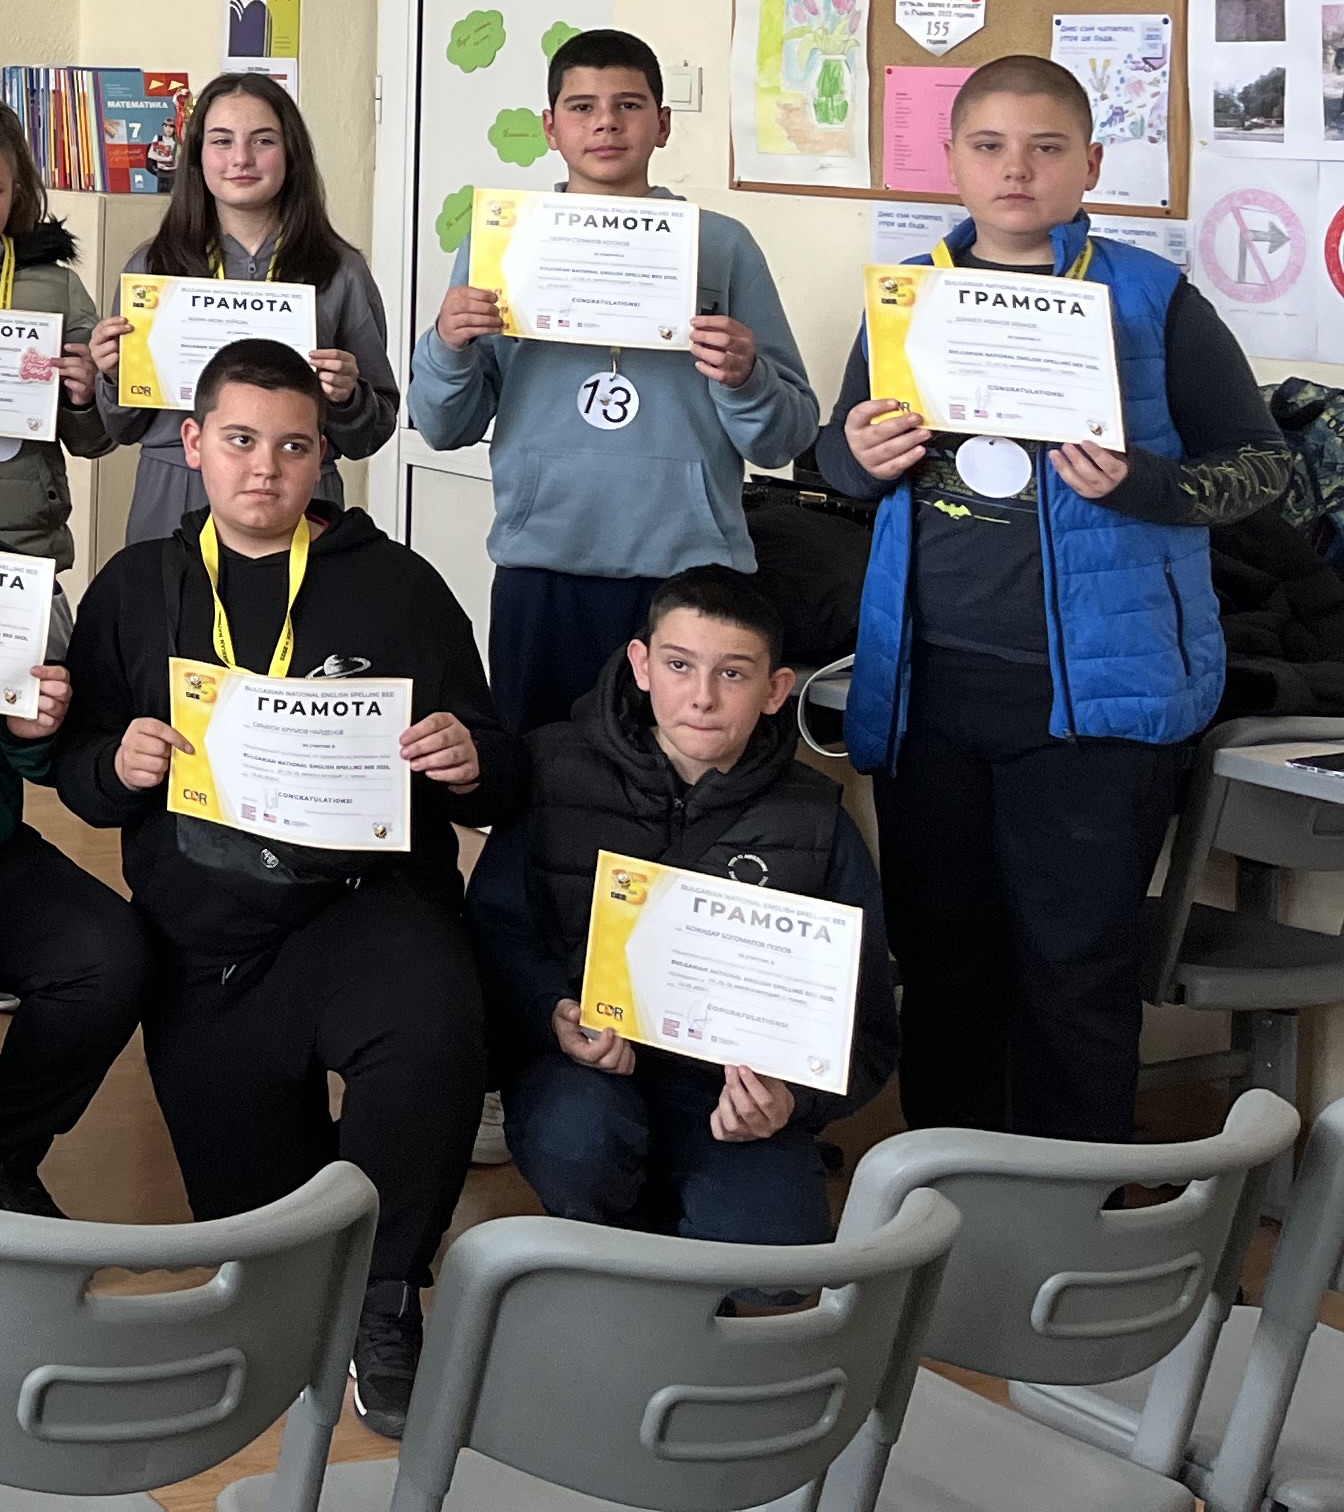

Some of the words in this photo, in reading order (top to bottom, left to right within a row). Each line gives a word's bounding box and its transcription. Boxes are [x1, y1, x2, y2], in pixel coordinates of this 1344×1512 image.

[926, 21, 950, 36] 155
[107, 101, 168, 109] МАТЕМАТИКА
[129, 123, 141, 138] 7
[554, 212, 671, 233] ГРАМОТА
[191, 295, 293, 313] ГРАМОТА
[958, 289, 1086, 318] ГРАМОТА
[583, 379, 631, 423] 13
[258, 697, 382, 717] ГРАМОТА
[692, 898, 832, 943] ГРАМОТА
